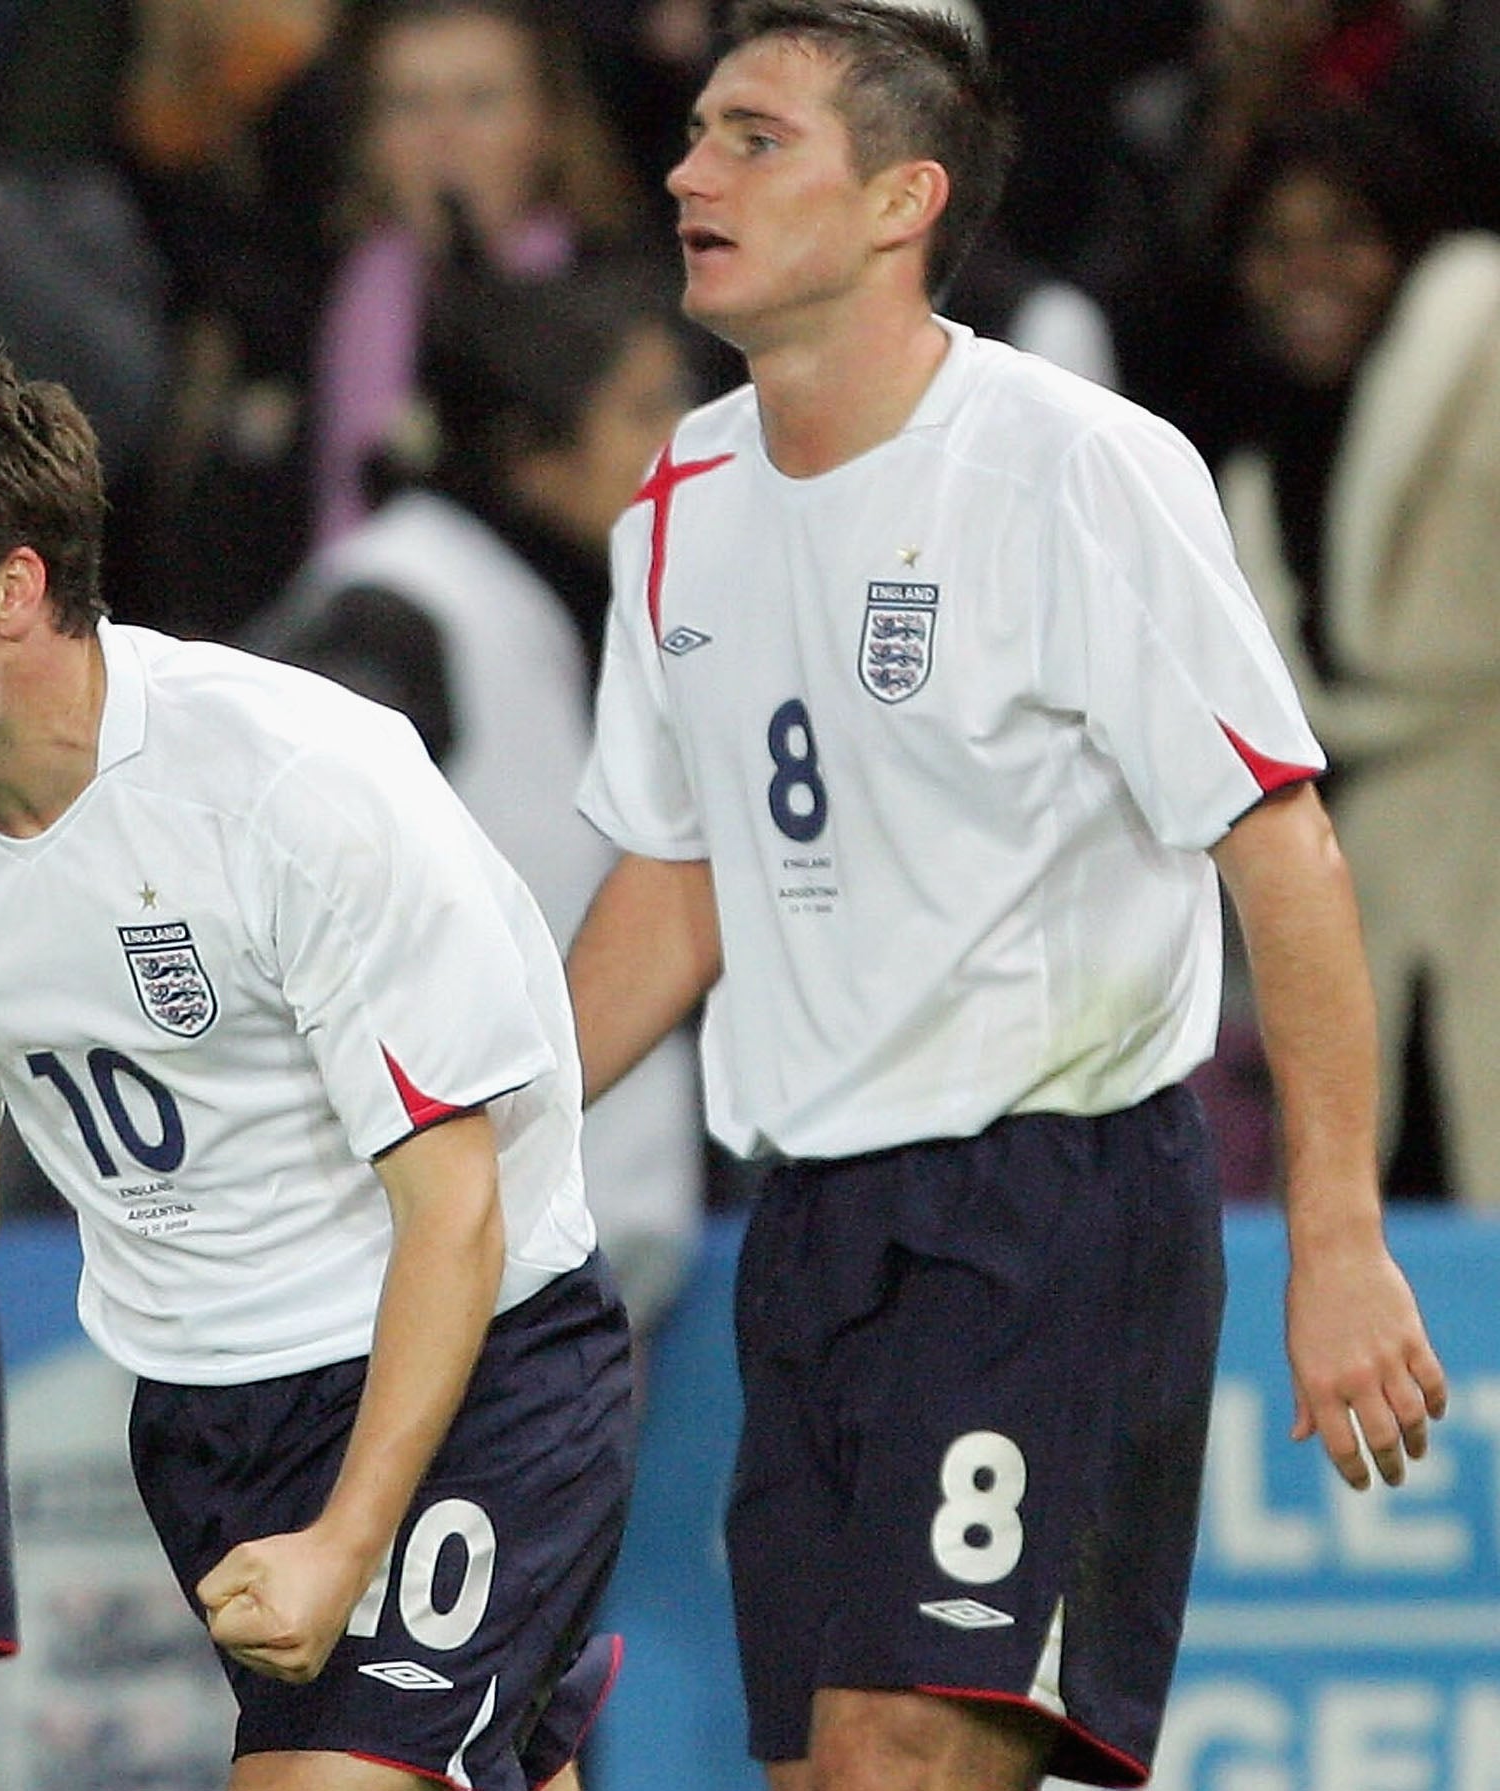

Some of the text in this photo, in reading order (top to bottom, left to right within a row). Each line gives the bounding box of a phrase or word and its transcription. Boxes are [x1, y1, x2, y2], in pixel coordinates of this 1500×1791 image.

[871, 586, 936, 601] ENGLAND
[768, 699, 828, 843] 8
[121, 926, 187, 944] ENGLAND
[25, 1048, 186, 1178] 10
[931, 1430, 1028, 1584] 8
